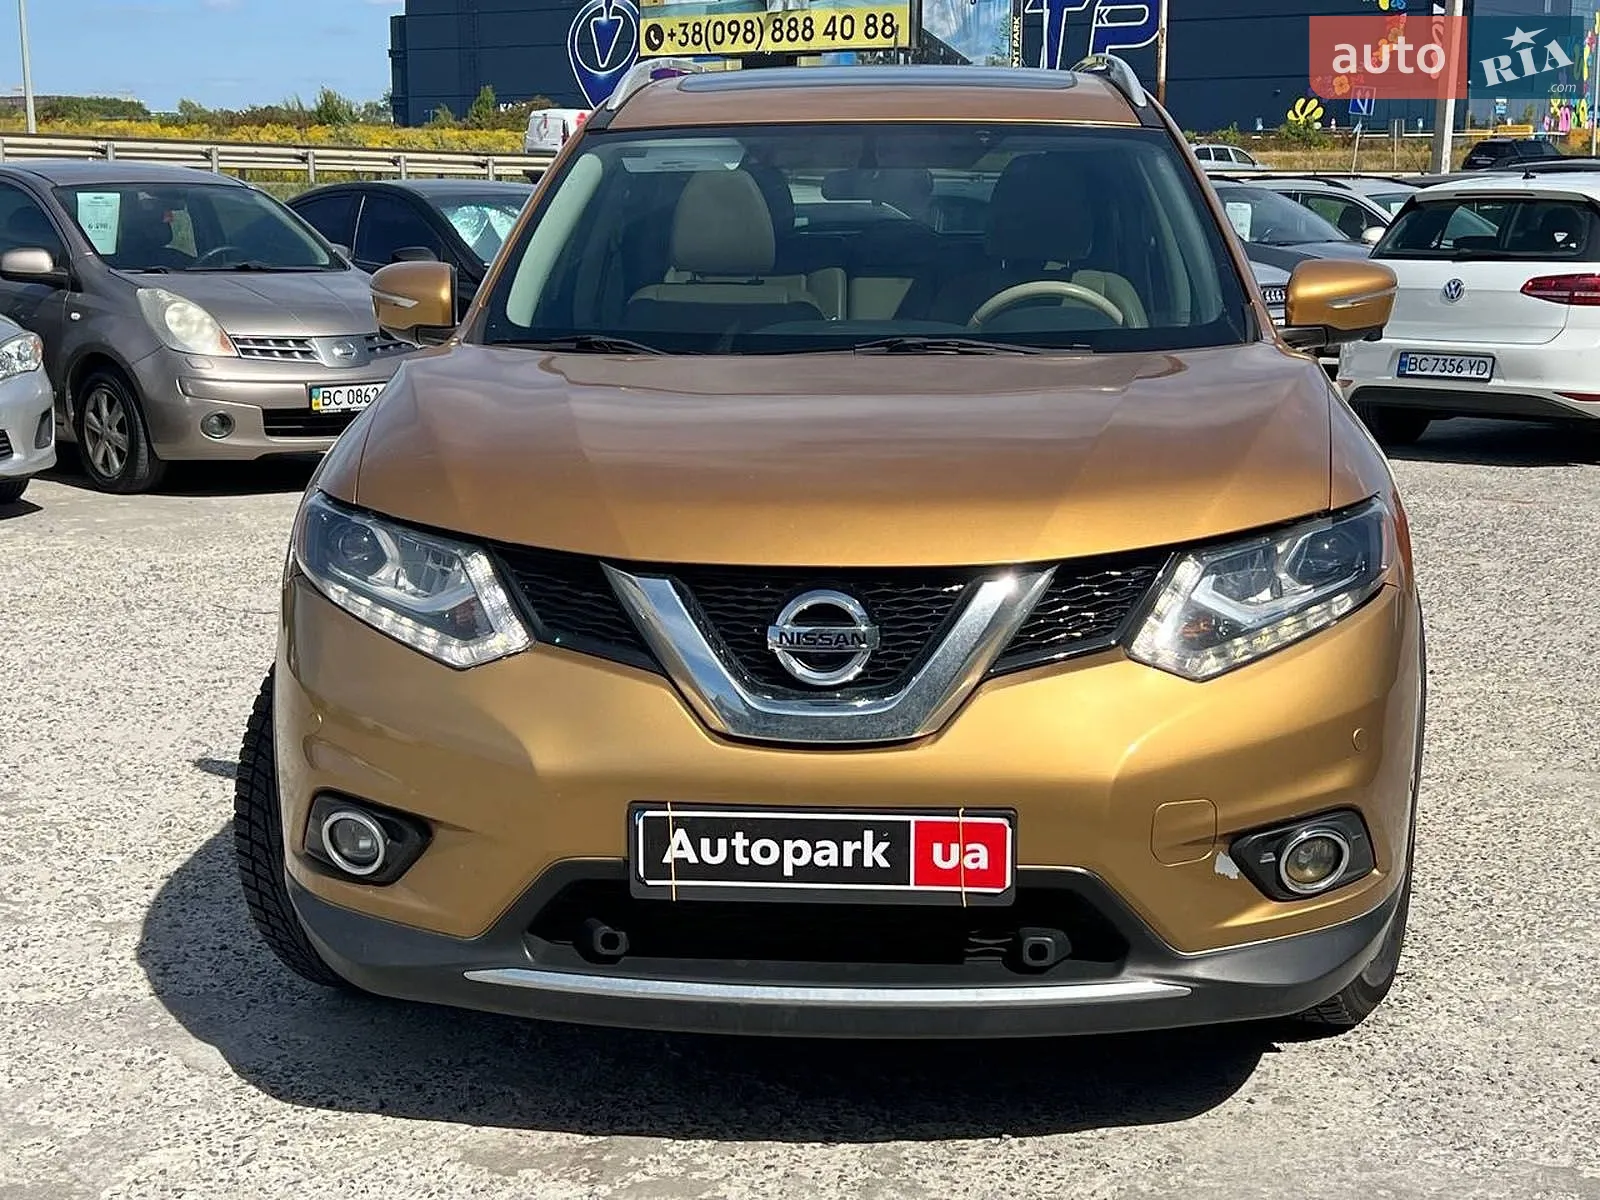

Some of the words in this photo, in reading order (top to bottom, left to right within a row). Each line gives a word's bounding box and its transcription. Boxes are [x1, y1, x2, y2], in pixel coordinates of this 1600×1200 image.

[668, 16, 764, 52] +38(098)
[770, 16, 815, 42] 888
[823, 15, 855, 41] 40
[863, 12, 896, 40] 88
[1012, 16, 1021, 48] PARK
[1407, 356, 1429, 372] BC
[1431, 357, 1464, 374] 7356
[1468, 359, 1488, 376] YD
[321, 389, 343, 406] BC
[779, 631, 867, 646] NISSAN
[661, 827, 892, 877] Autopark
[931, 841, 989, 871] ua
